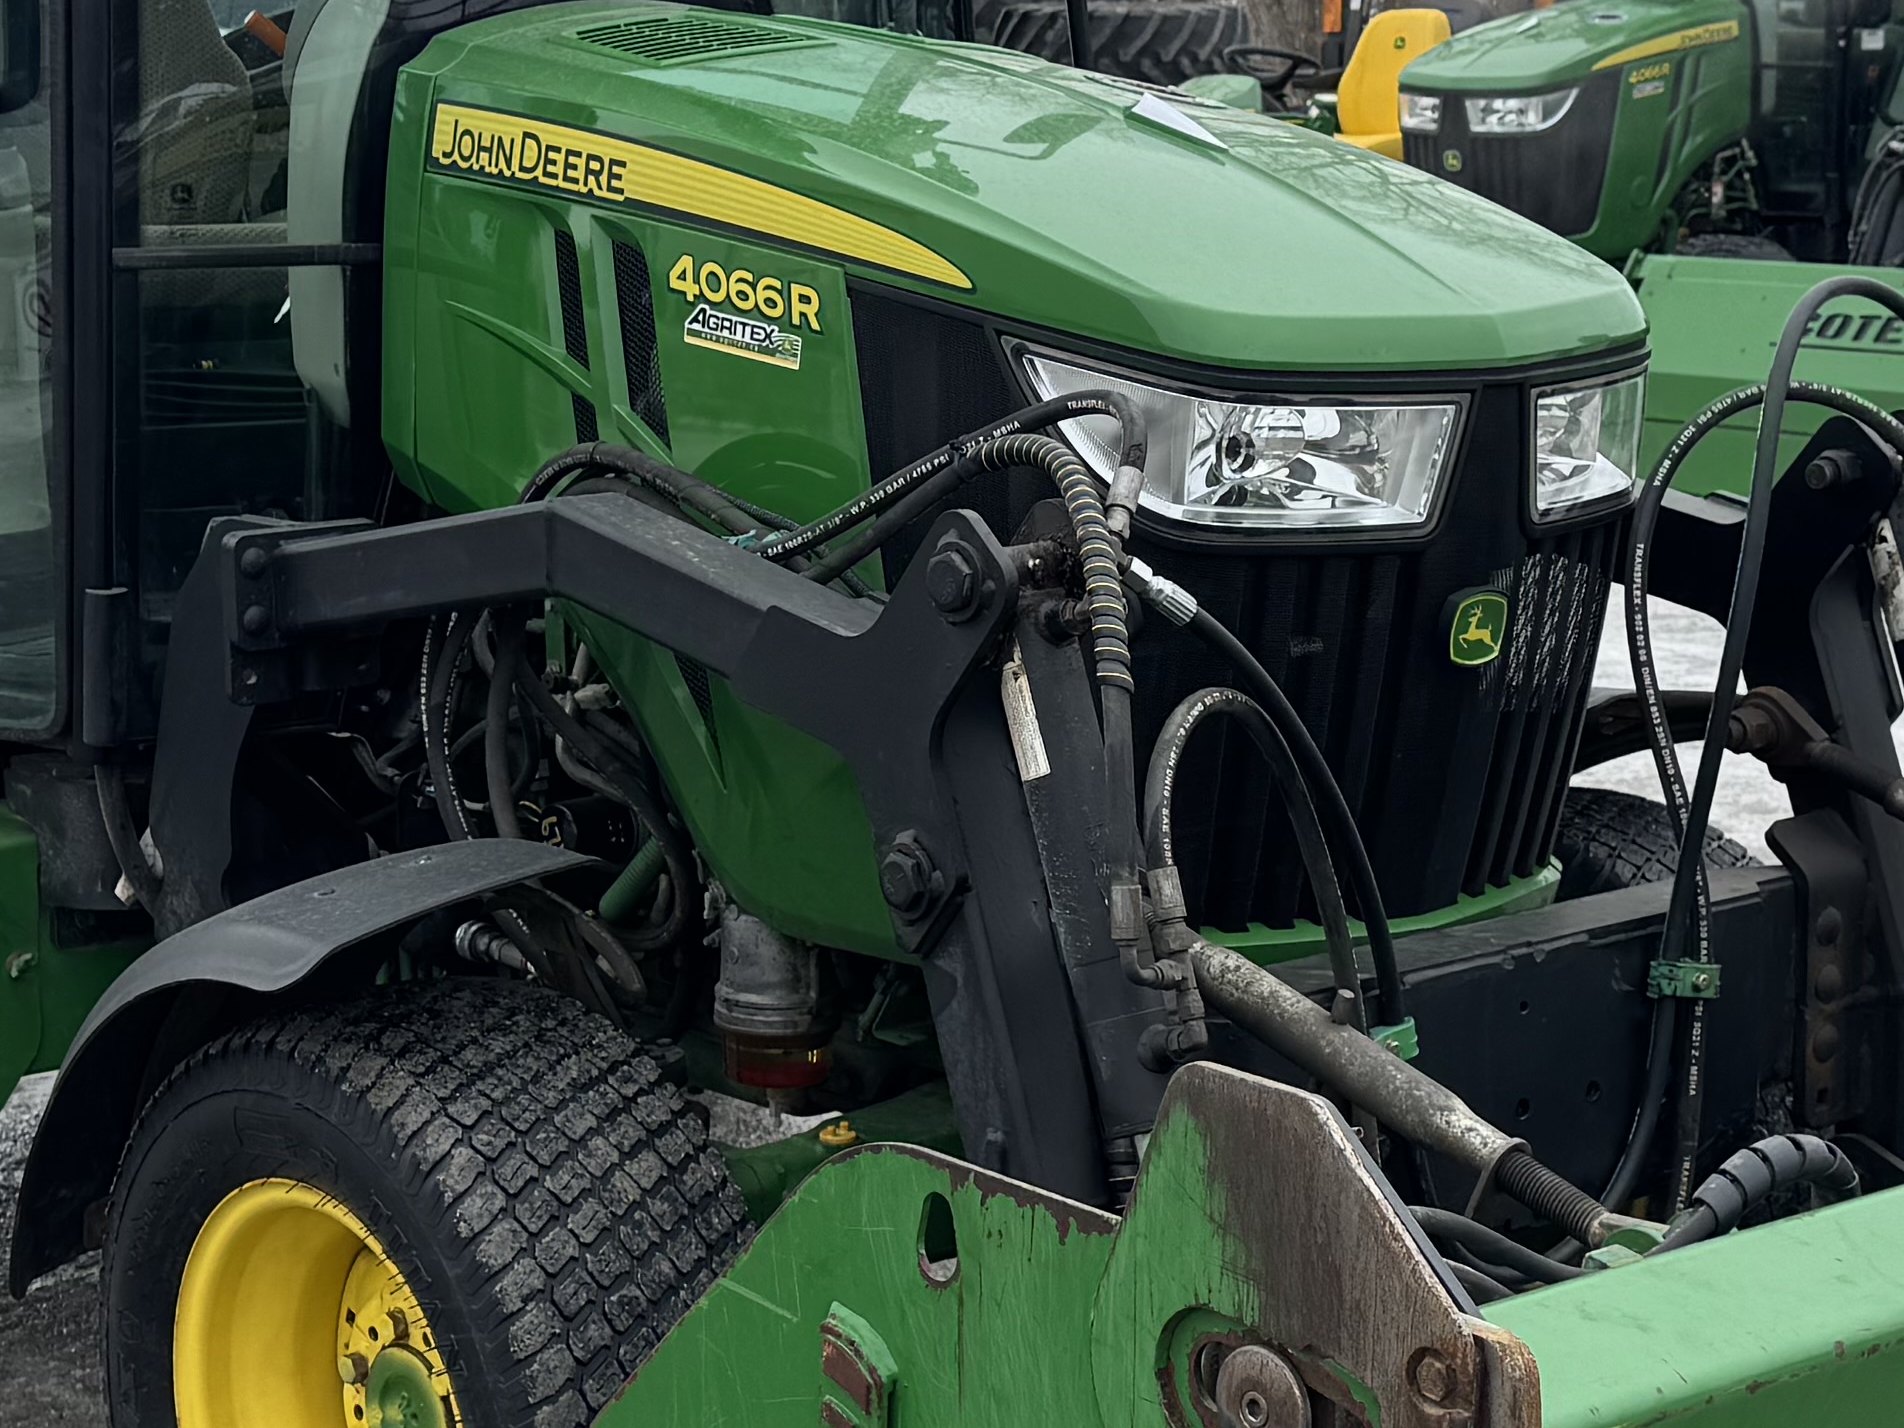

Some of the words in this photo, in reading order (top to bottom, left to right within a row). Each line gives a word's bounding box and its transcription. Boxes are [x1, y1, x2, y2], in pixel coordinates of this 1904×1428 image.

[442, 118, 515, 172] JOHN
[518, 130, 627, 196] DEERE
[688, 307, 776, 346] AGRITEX
[1632, 543, 1645, 605] TRANSFLEX
